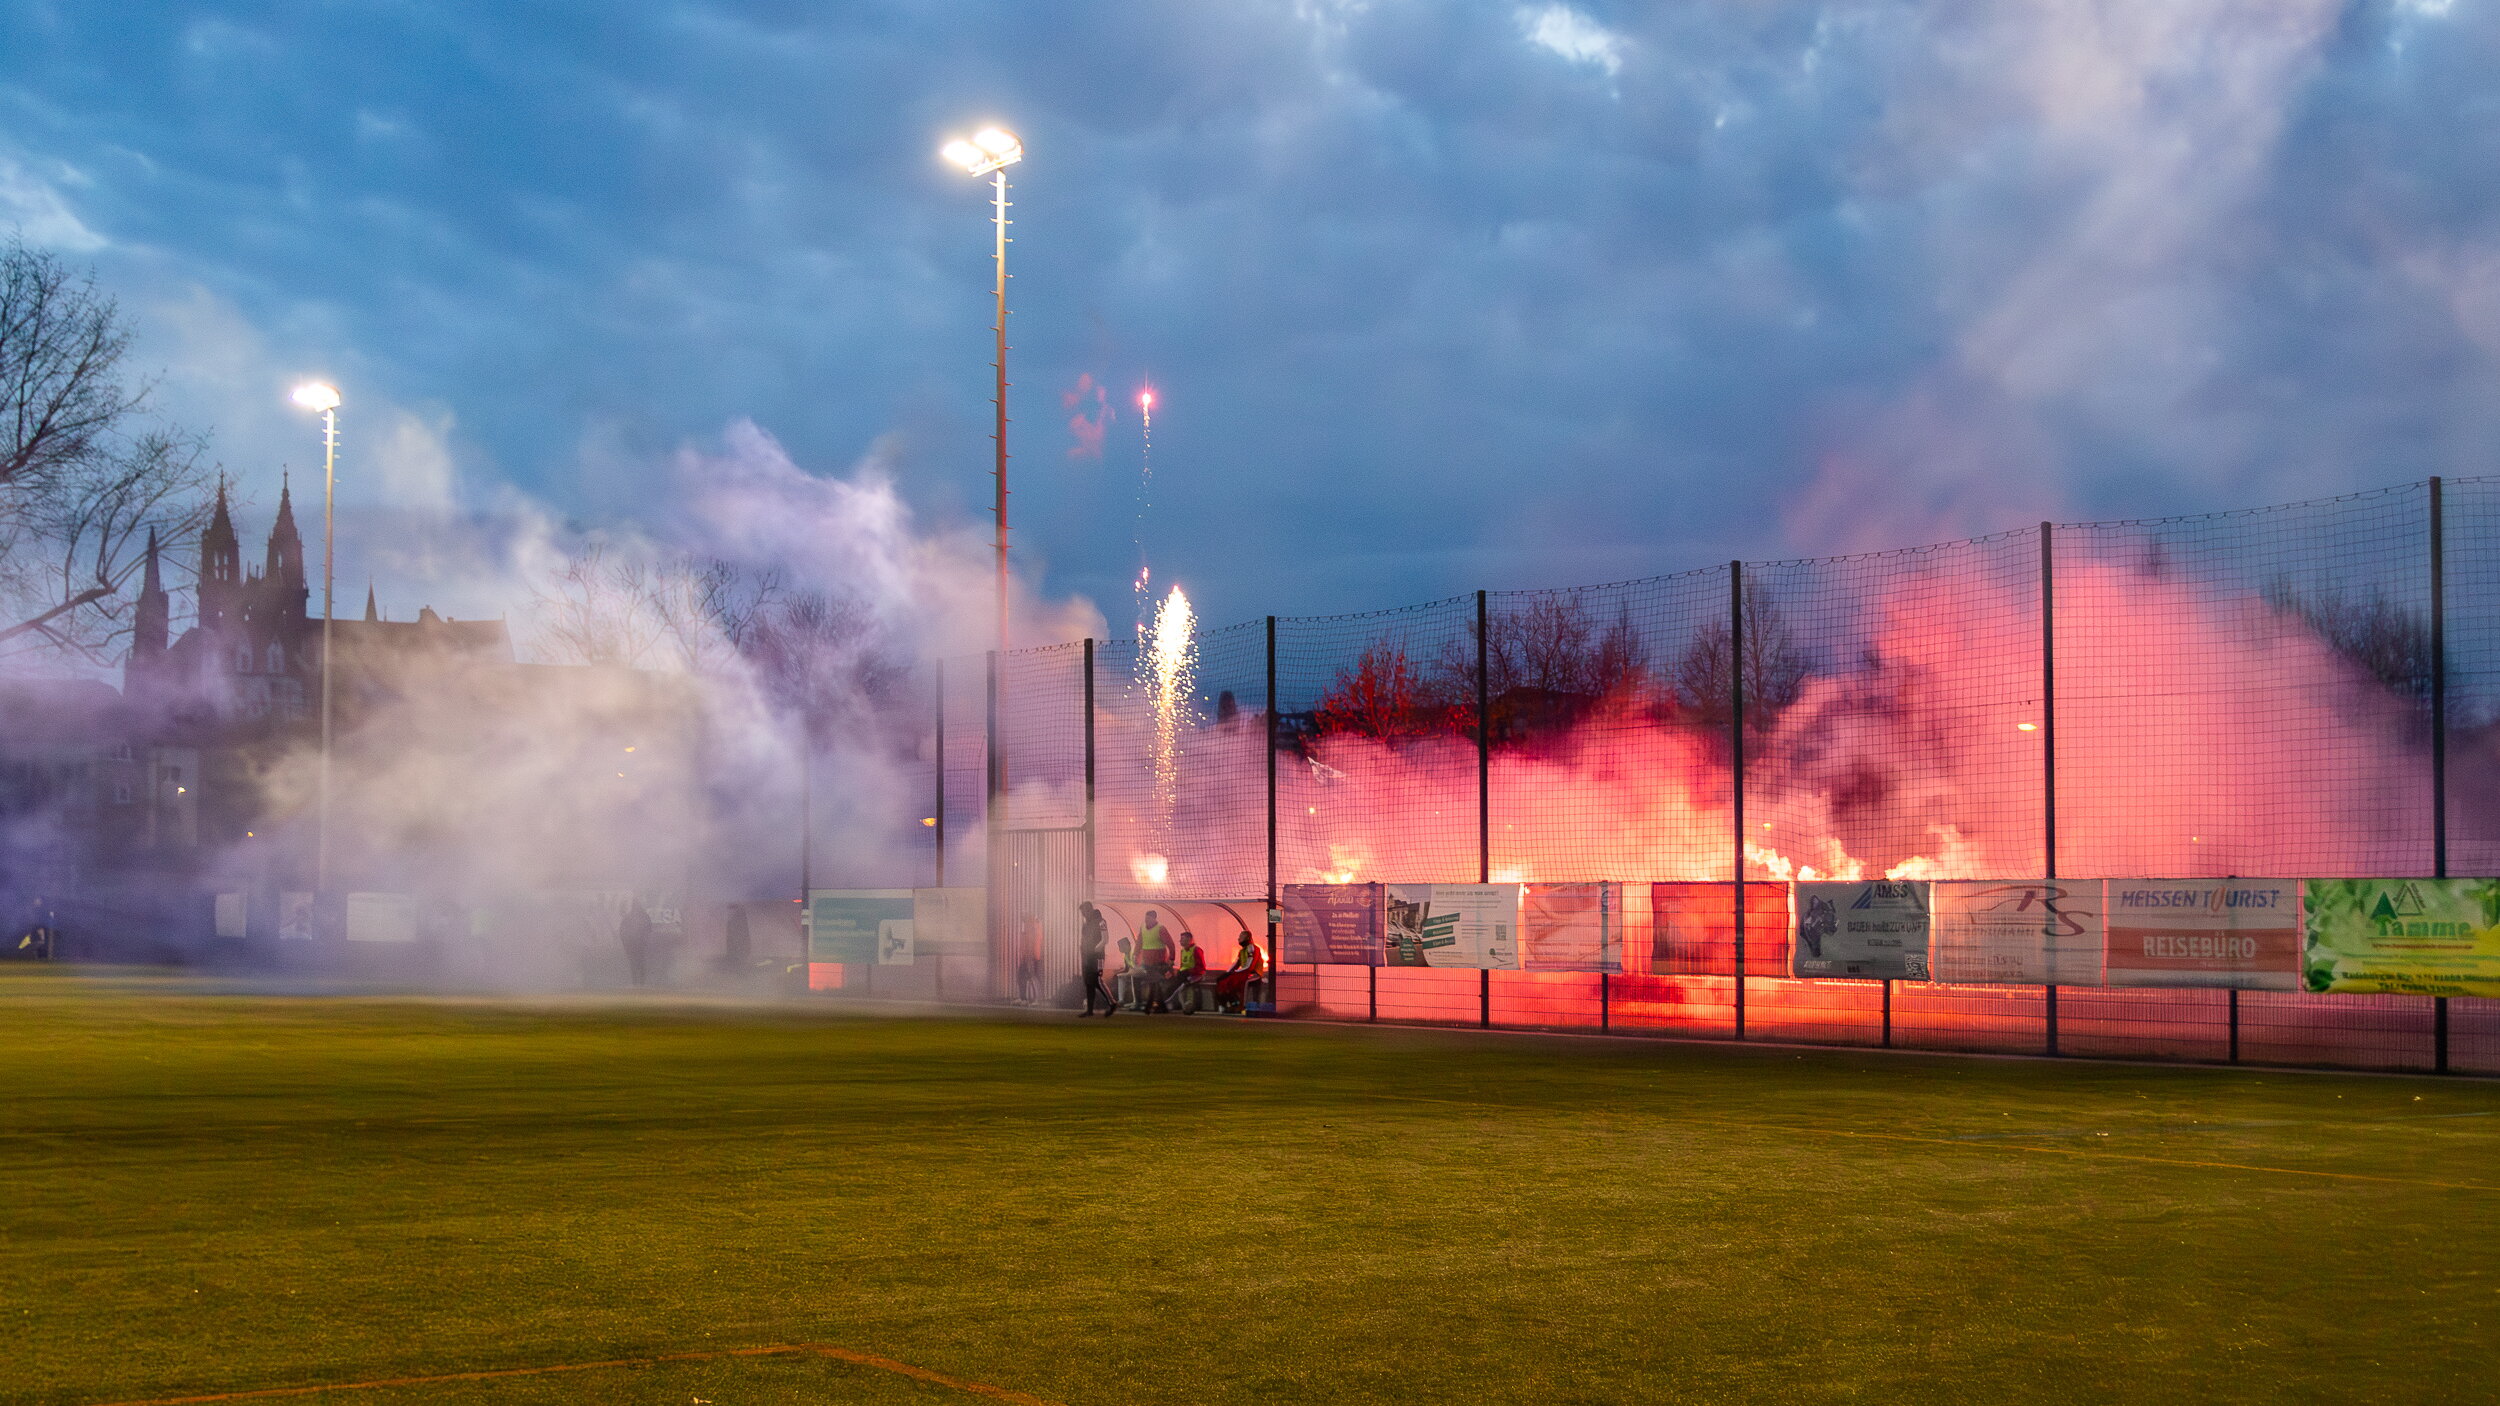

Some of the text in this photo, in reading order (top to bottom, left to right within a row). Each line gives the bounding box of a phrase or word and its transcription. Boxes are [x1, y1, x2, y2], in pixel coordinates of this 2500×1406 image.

[1873, 884, 1909, 899] AMSS
[2120, 887, 2280, 913] MEISSEN TOURIST
[2143, 931, 2257, 959] REISEBÜRO
